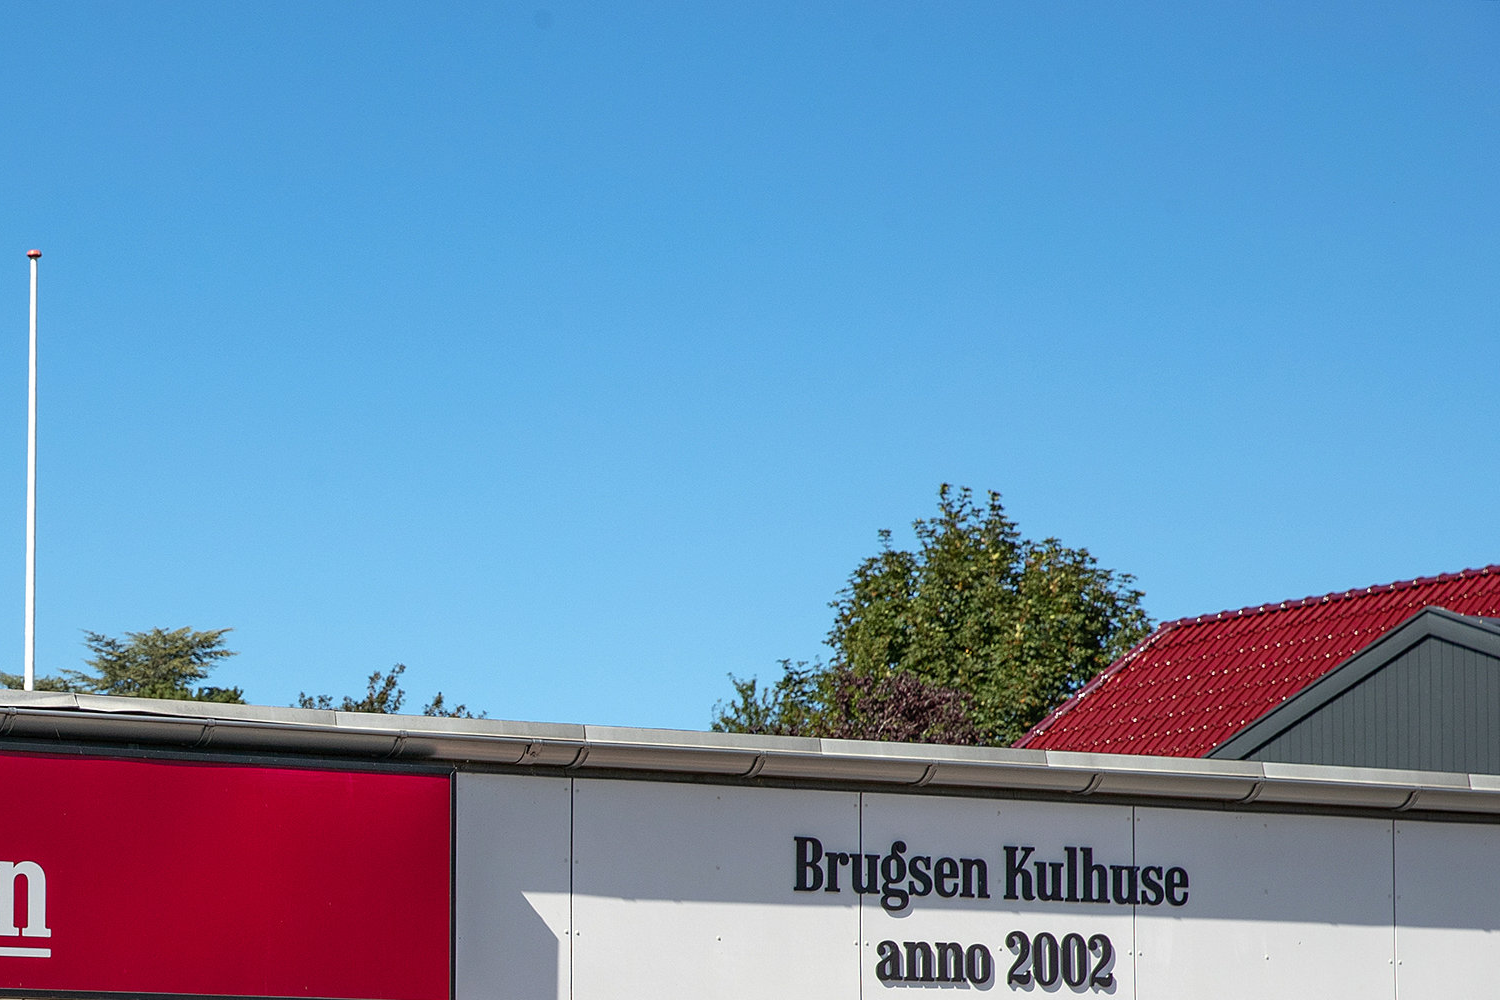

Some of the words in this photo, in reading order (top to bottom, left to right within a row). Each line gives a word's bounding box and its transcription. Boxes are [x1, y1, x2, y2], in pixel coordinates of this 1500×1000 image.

[793, 836, 991, 911] Brugsen
[1003, 845, 1189, 907] Kulhuse
[875, 940, 991, 984] anno
[1005, 931, 1114, 987] 2002
